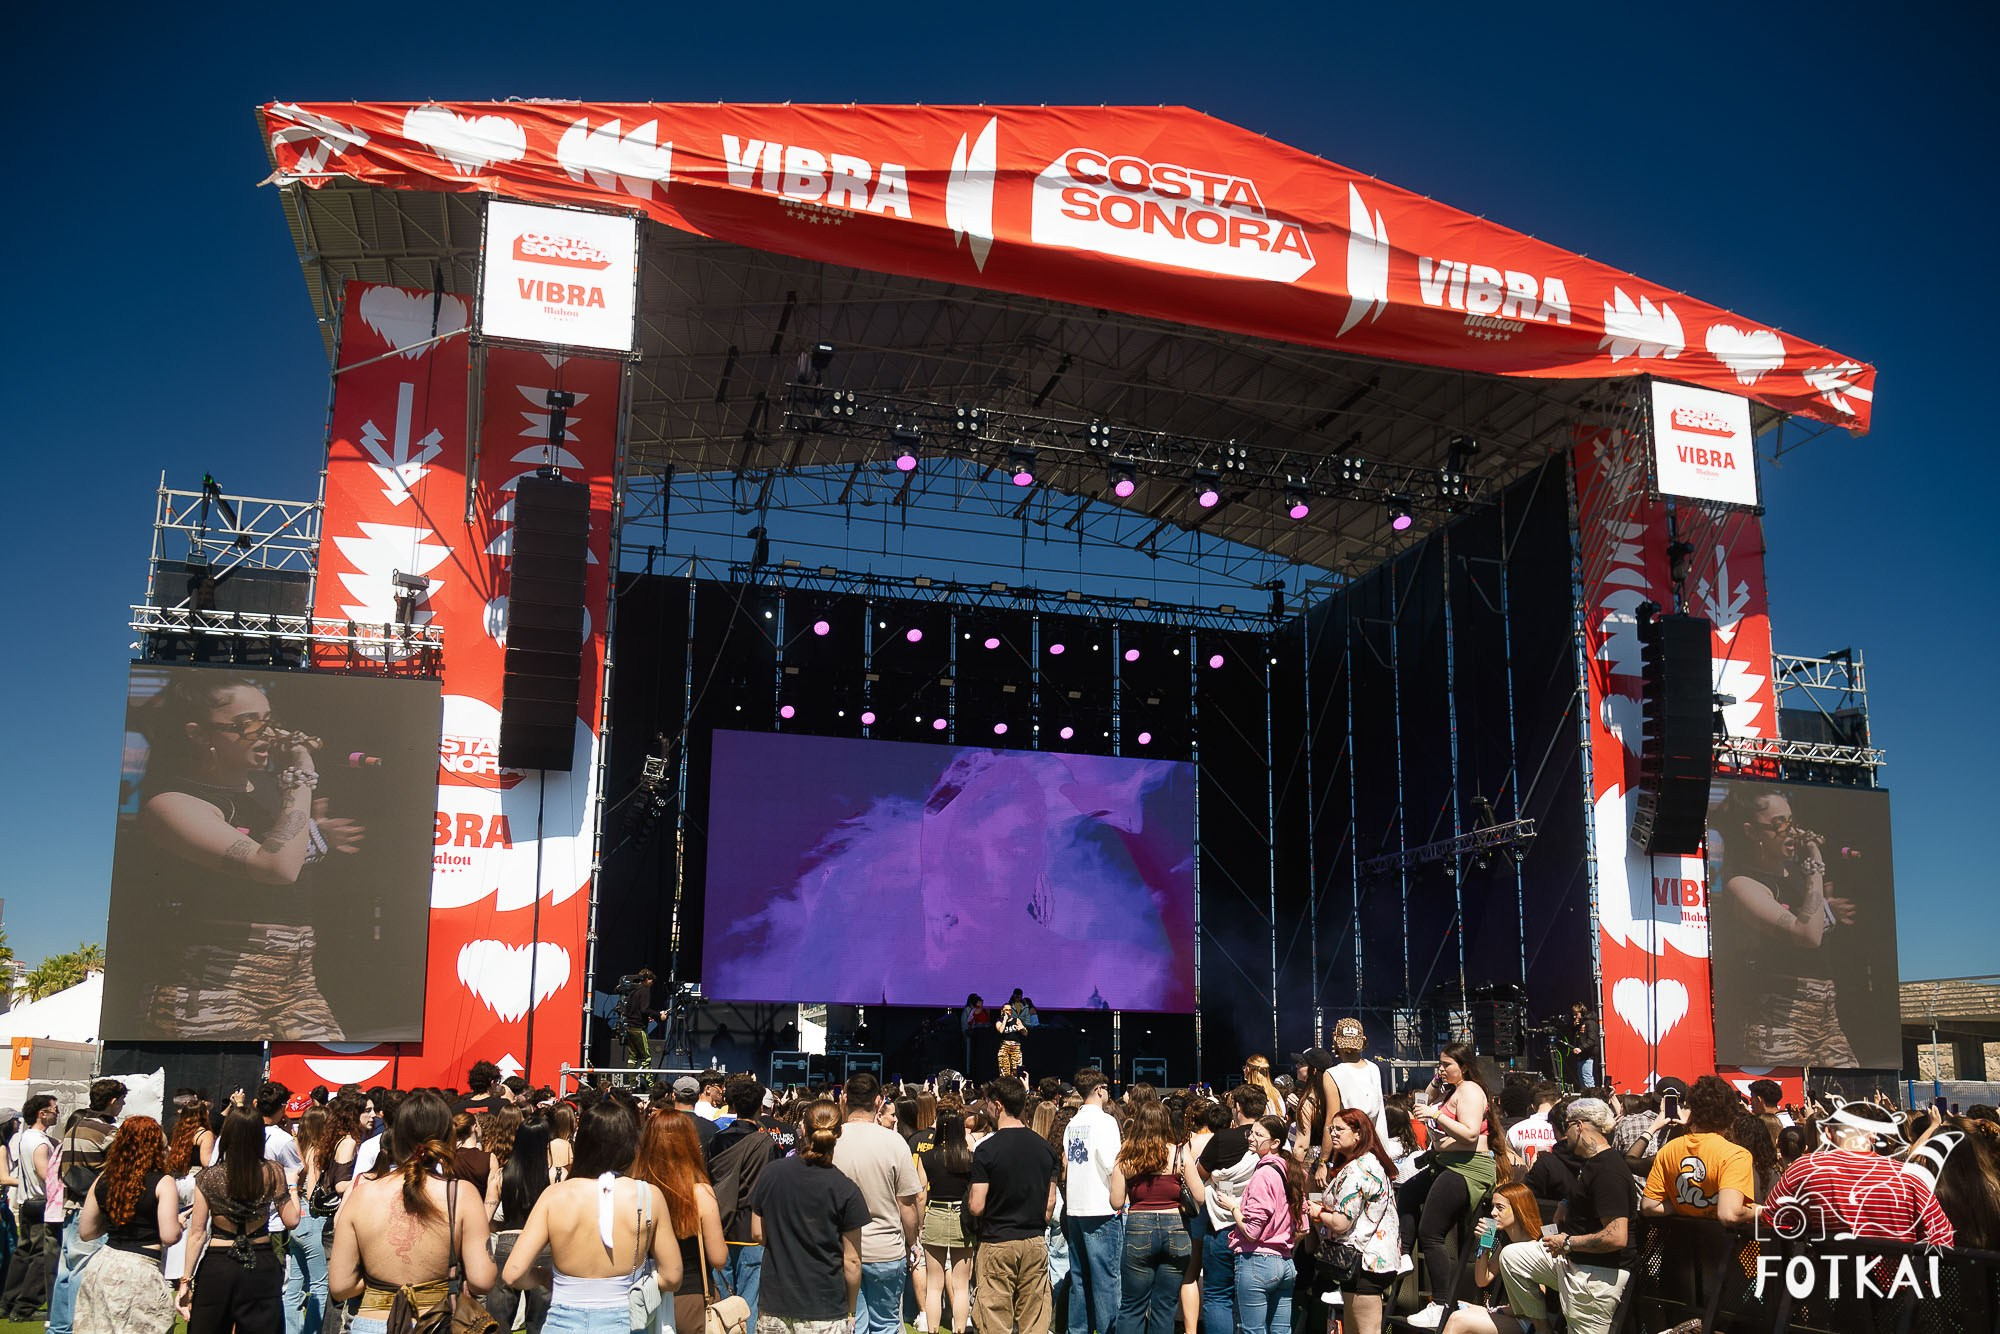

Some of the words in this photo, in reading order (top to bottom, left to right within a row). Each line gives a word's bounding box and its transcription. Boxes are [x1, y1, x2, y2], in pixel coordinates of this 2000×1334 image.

[721, 134, 912, 219] VIBRA
[1065, 151, 1265, 215] COSTA
[1061, 187, 1312, 260] SONORA
[520, 240, 612, 263] SONORA
[521, 231, 597, 250] COSTA
[518, 278, 606, 309] VIBRA
[1418, 256, 1571, 325] VIBRA
[1677, 445, 1736, 470] VIBRA
[440, 735, 500, 756] STA
[440, 753, 524, 776] NOR
[432, 811, 513, 849] BRA
[433, 852, 471, 865] ahou
[1653, 876, 1707, 907] VIB
[1517, 1129, 1555, 1140] MARADO
